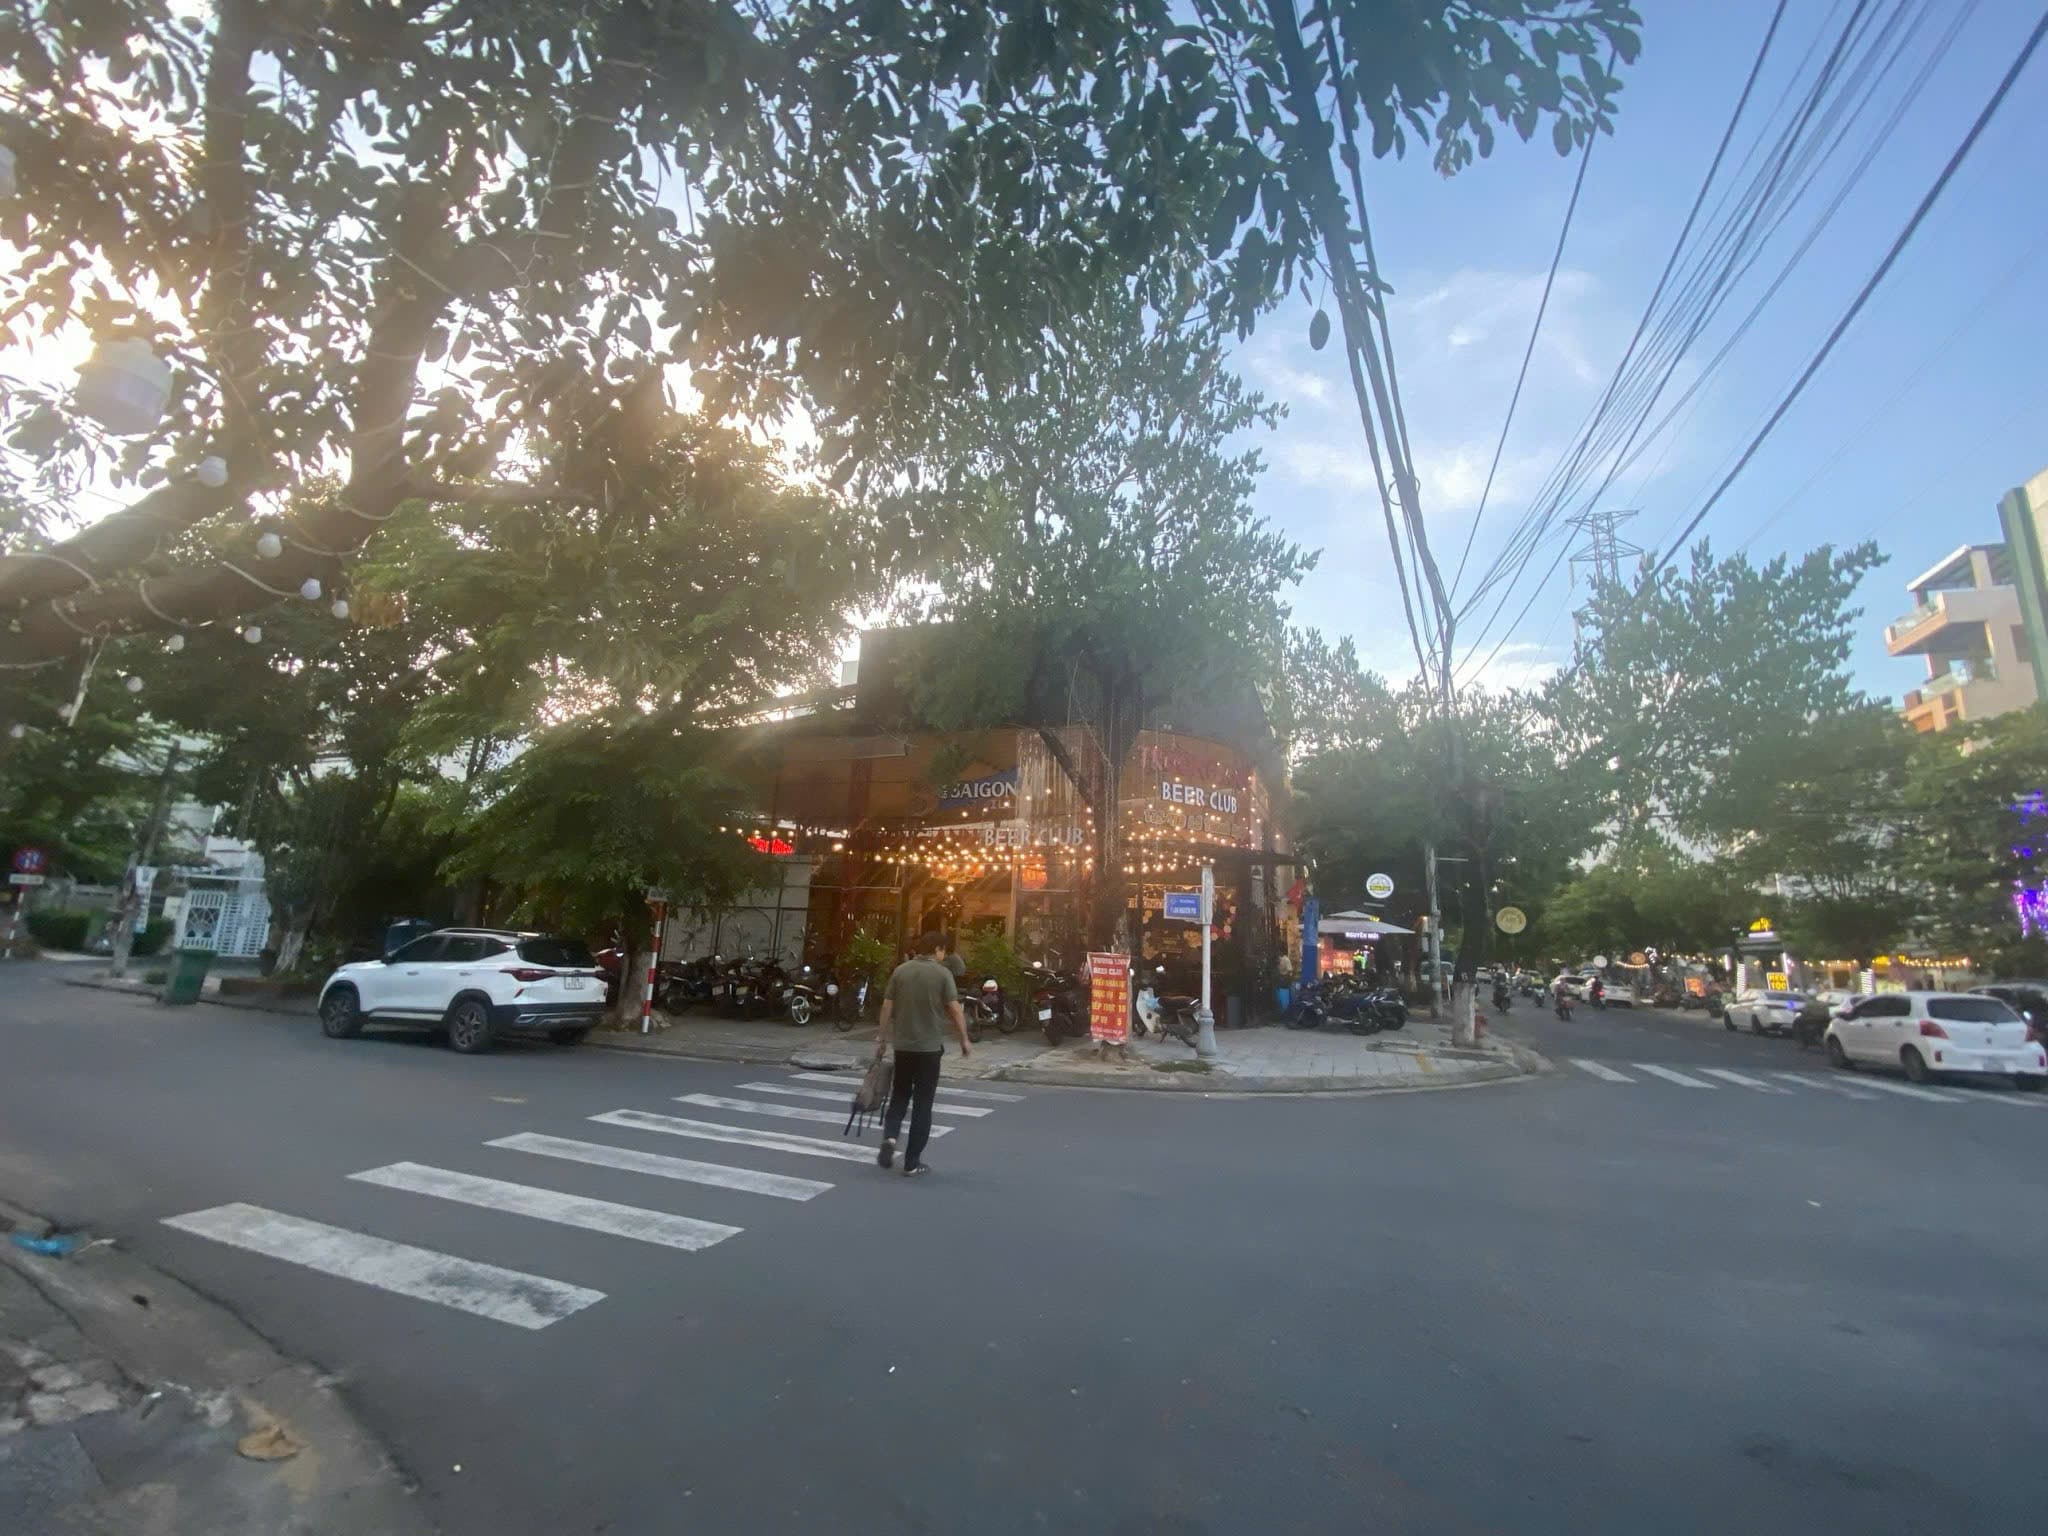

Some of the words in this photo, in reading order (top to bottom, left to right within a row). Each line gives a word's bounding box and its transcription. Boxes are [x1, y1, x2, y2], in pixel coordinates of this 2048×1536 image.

[951, 781, 1017, 798] SAIGON
[1162, 782, 1205, 806] BEER
[1210, 790, 1238, 814] CLUB
[984, 827, 1030, 847] BEER
[1037, 827, 1084, 847] CLUB
